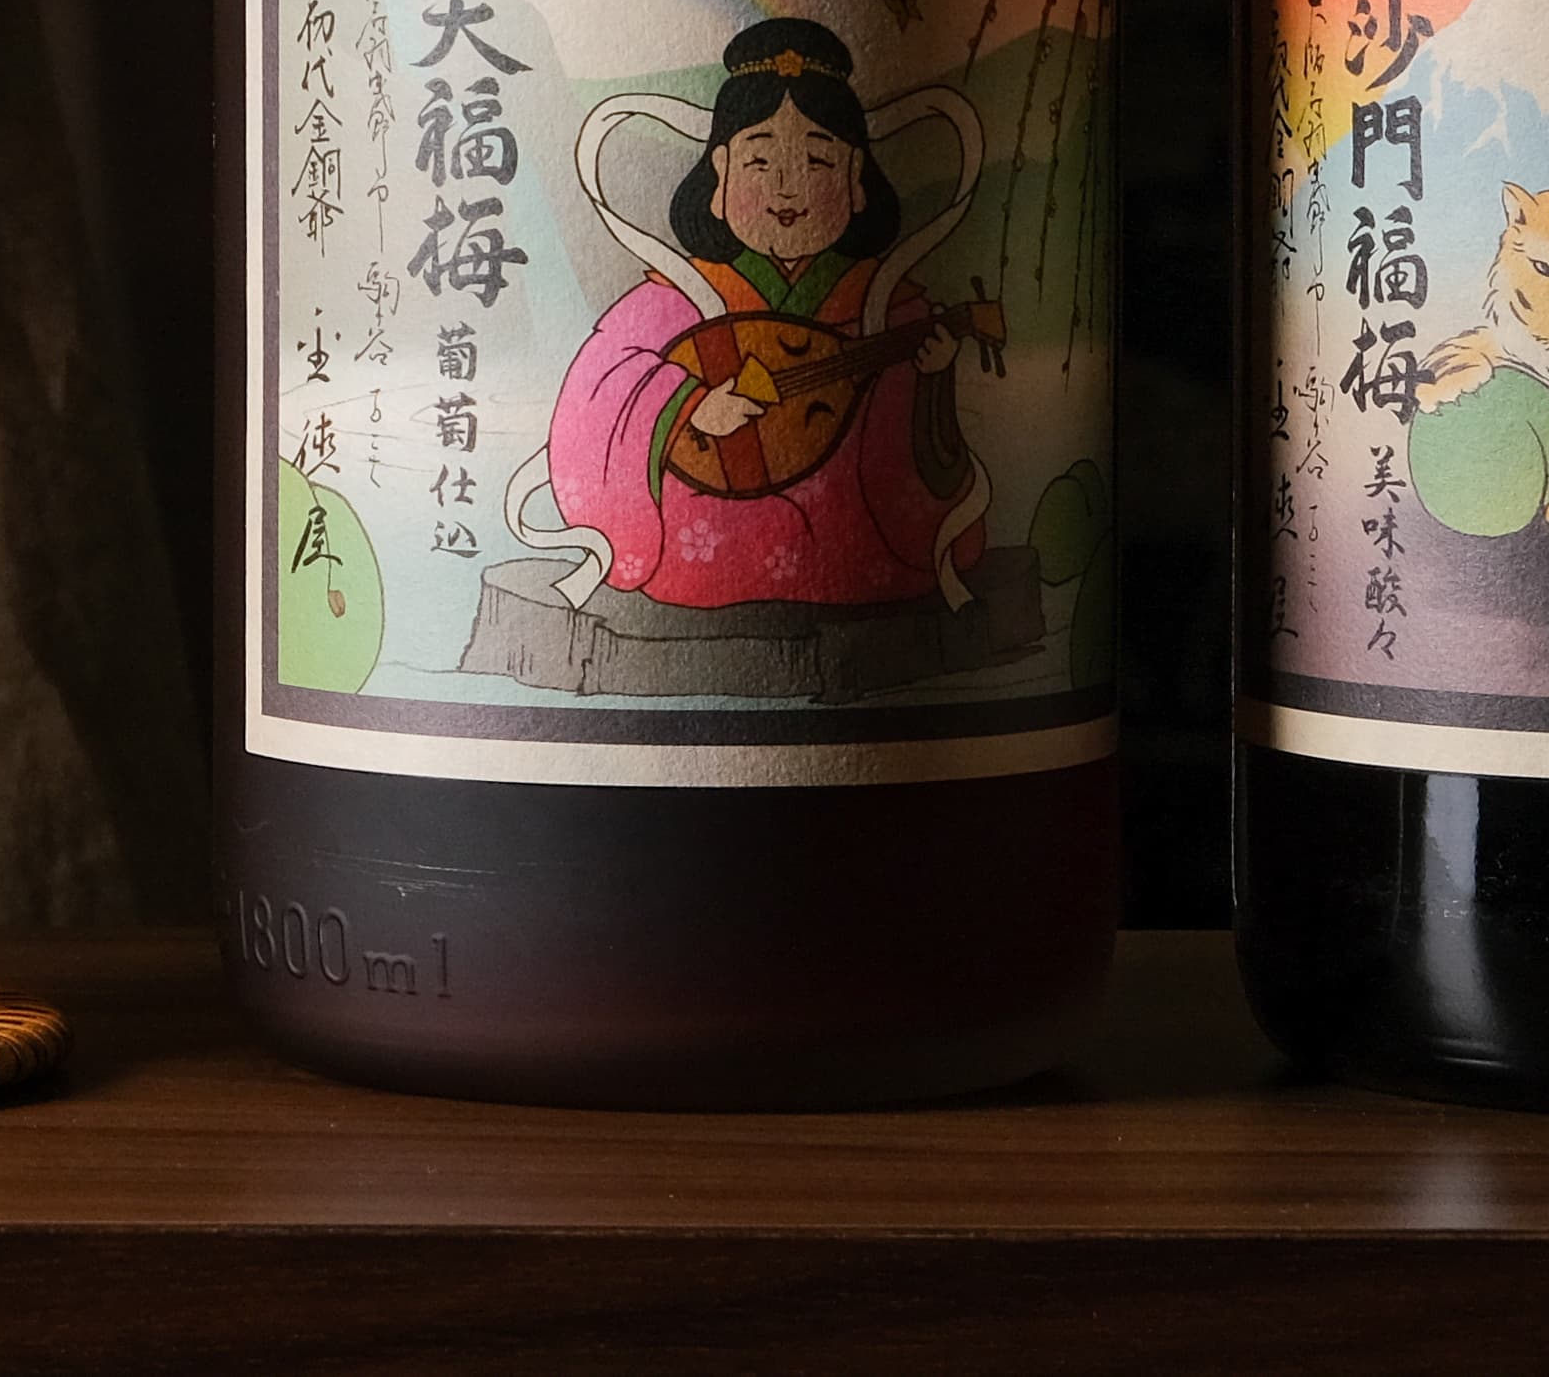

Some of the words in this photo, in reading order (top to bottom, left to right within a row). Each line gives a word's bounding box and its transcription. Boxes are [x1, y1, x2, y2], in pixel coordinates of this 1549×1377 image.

[429, 323, 483, 557] 葡萄仕込
[1361, 445, 1407, 660] 美味酸々
